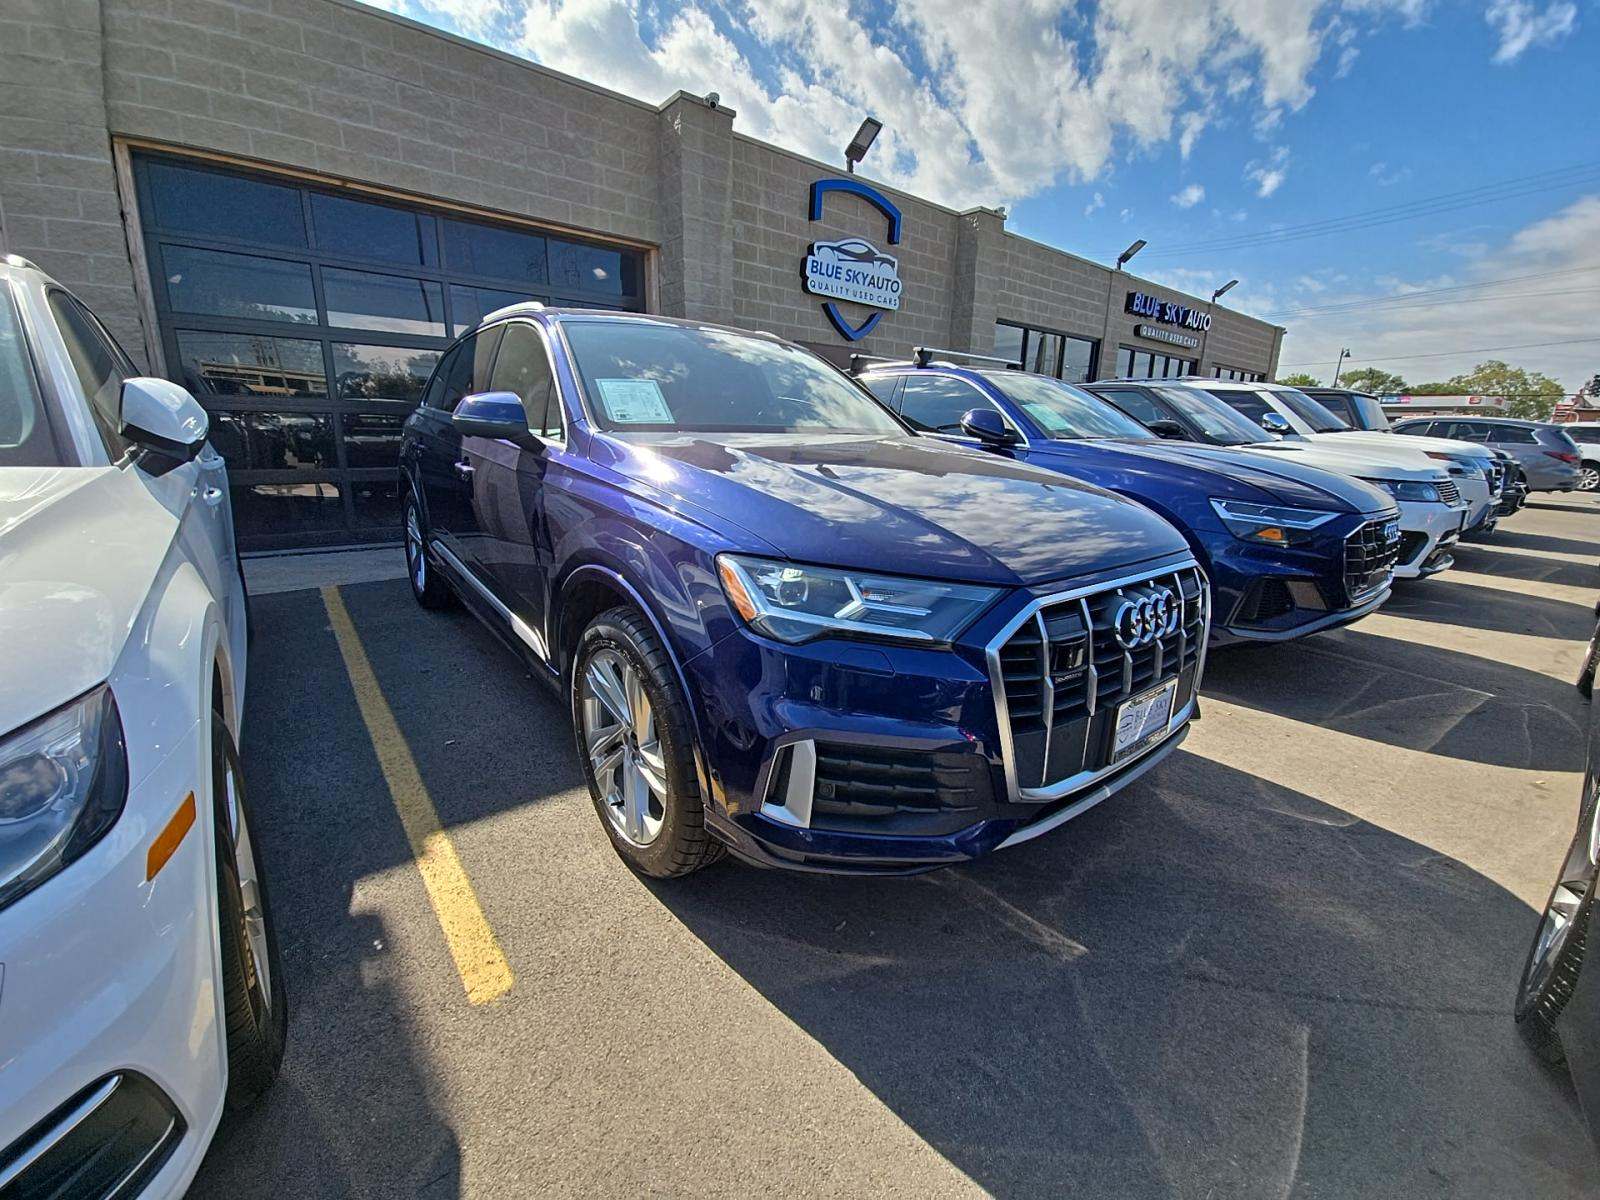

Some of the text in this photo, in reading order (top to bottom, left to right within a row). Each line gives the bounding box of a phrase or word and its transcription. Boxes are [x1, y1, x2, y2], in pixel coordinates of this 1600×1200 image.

[810, 259, 842, 281] BLUE
[810, 280, 898, 307] QUALITY USED CARS
[1132, 292, 1212, 331] BLUE SKY AUTO
